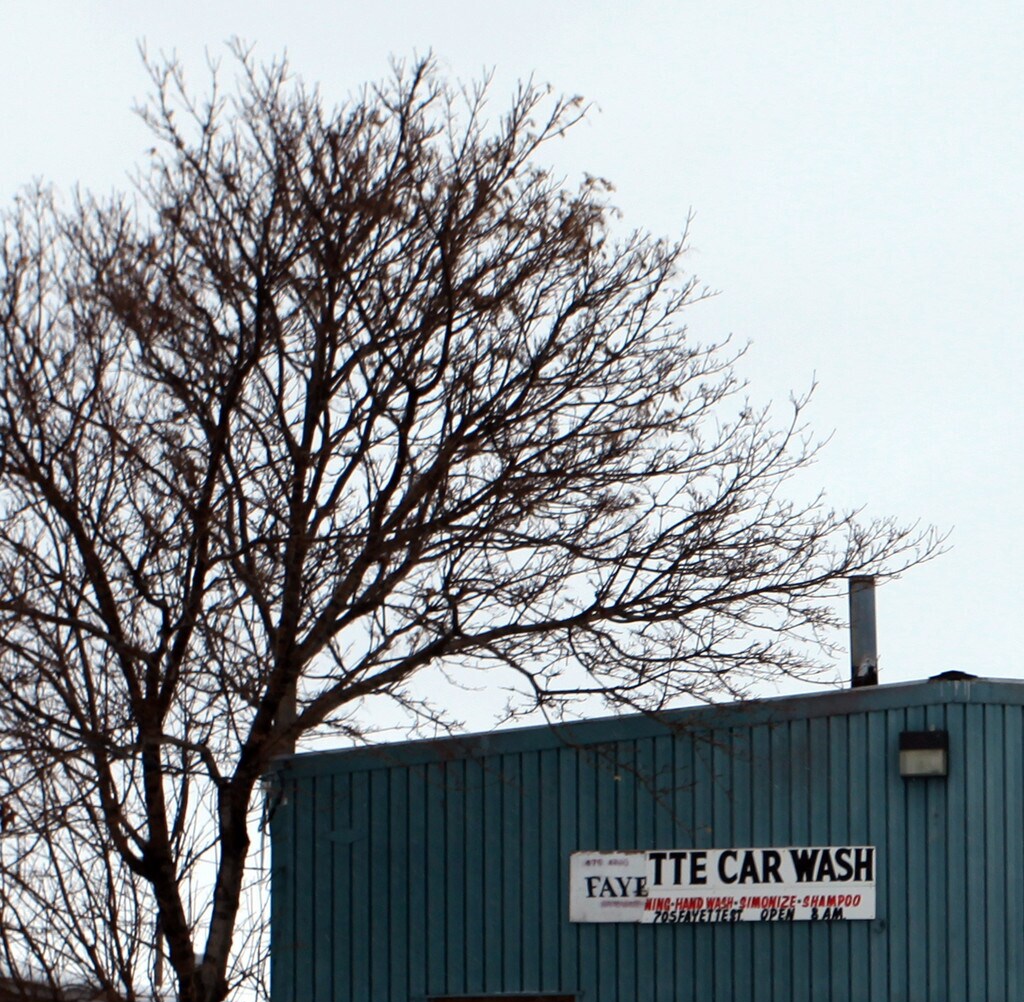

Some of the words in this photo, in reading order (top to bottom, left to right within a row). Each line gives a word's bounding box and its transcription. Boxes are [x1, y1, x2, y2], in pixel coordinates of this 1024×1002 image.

[717, 850, 784, 885] CAR
[789, 848, 875, 883] WASH
[802, 894, 862, 908] SHAMPOO
[761, 908, 796, 920] OPEN
[811, 907, 819, 920] 8
